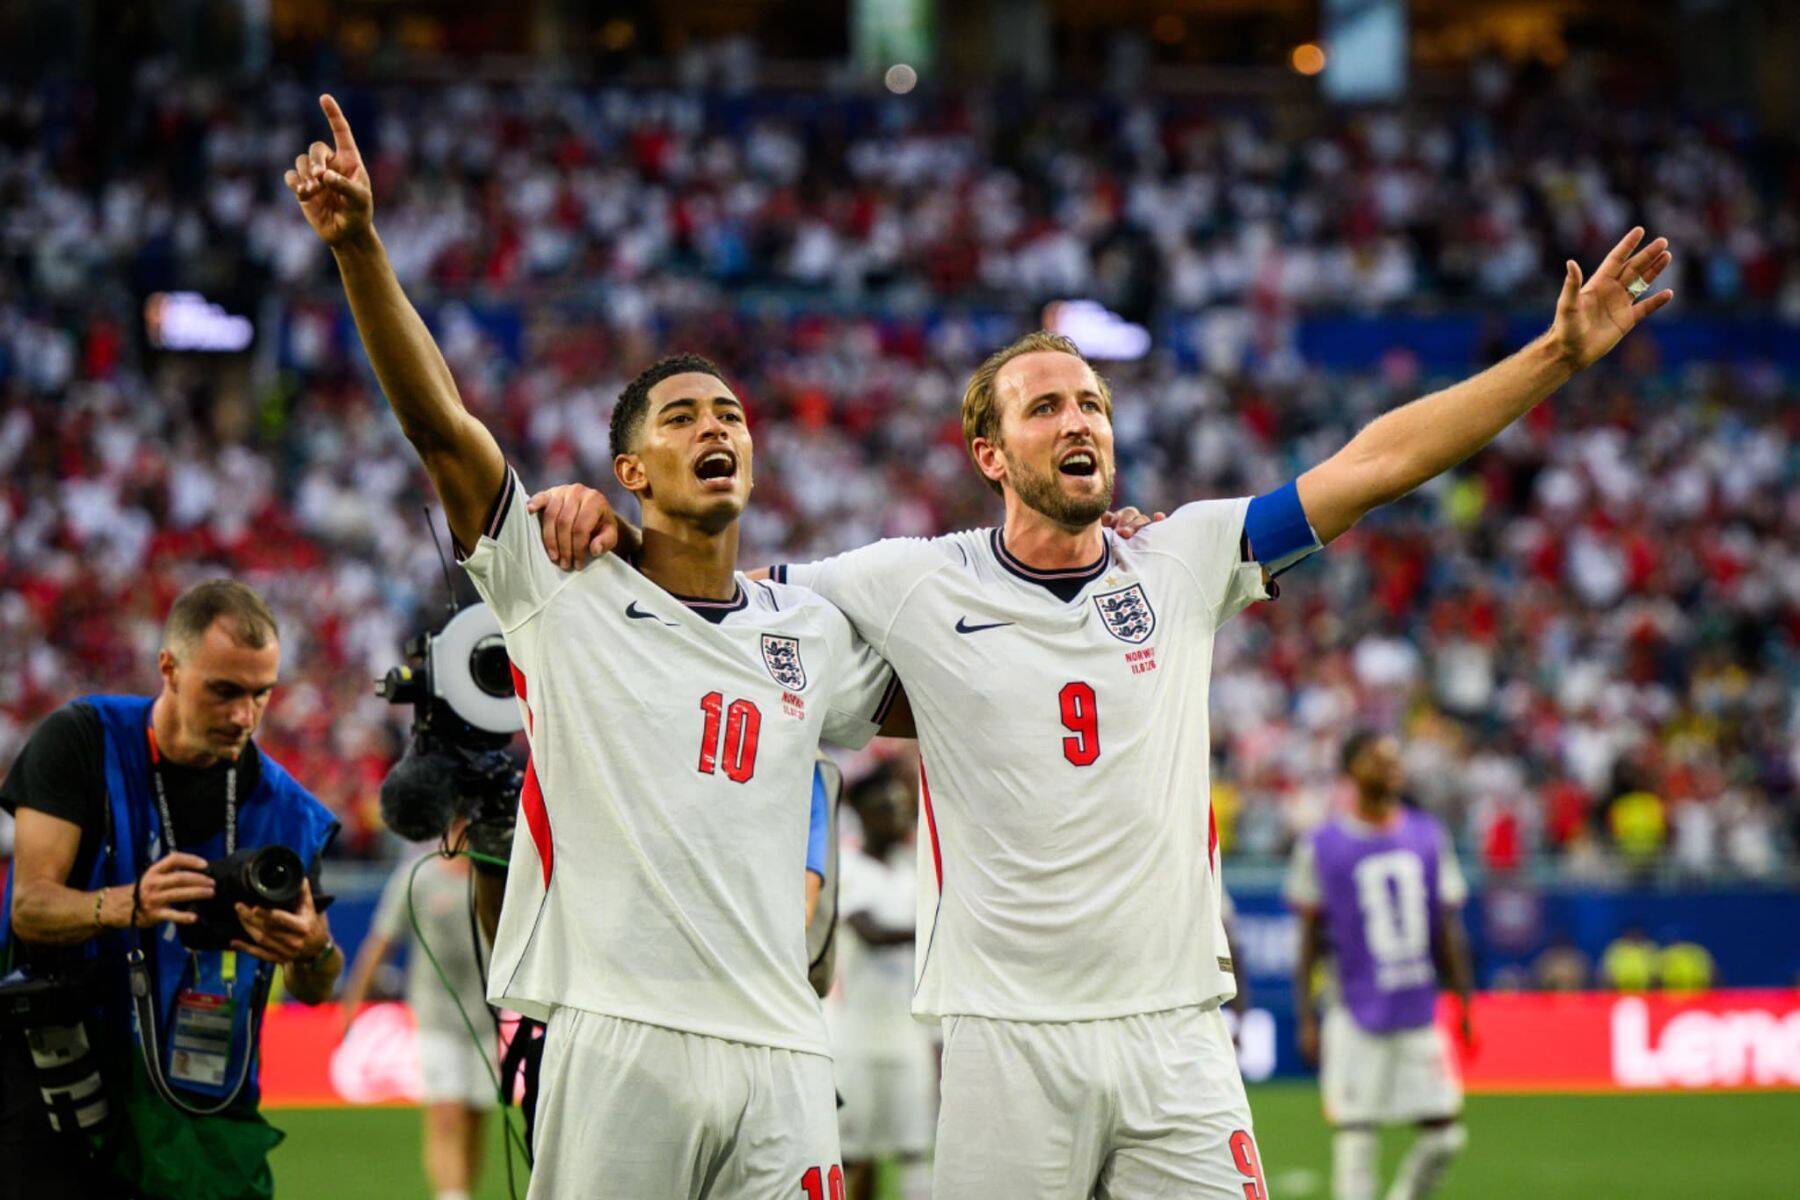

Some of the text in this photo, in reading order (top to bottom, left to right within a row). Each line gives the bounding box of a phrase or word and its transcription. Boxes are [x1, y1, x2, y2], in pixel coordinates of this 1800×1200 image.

[698, 690, 762, 784] 10
[1058, 681, 1101, 767] 9
[1228, 1129, 1269, 1200] 9
